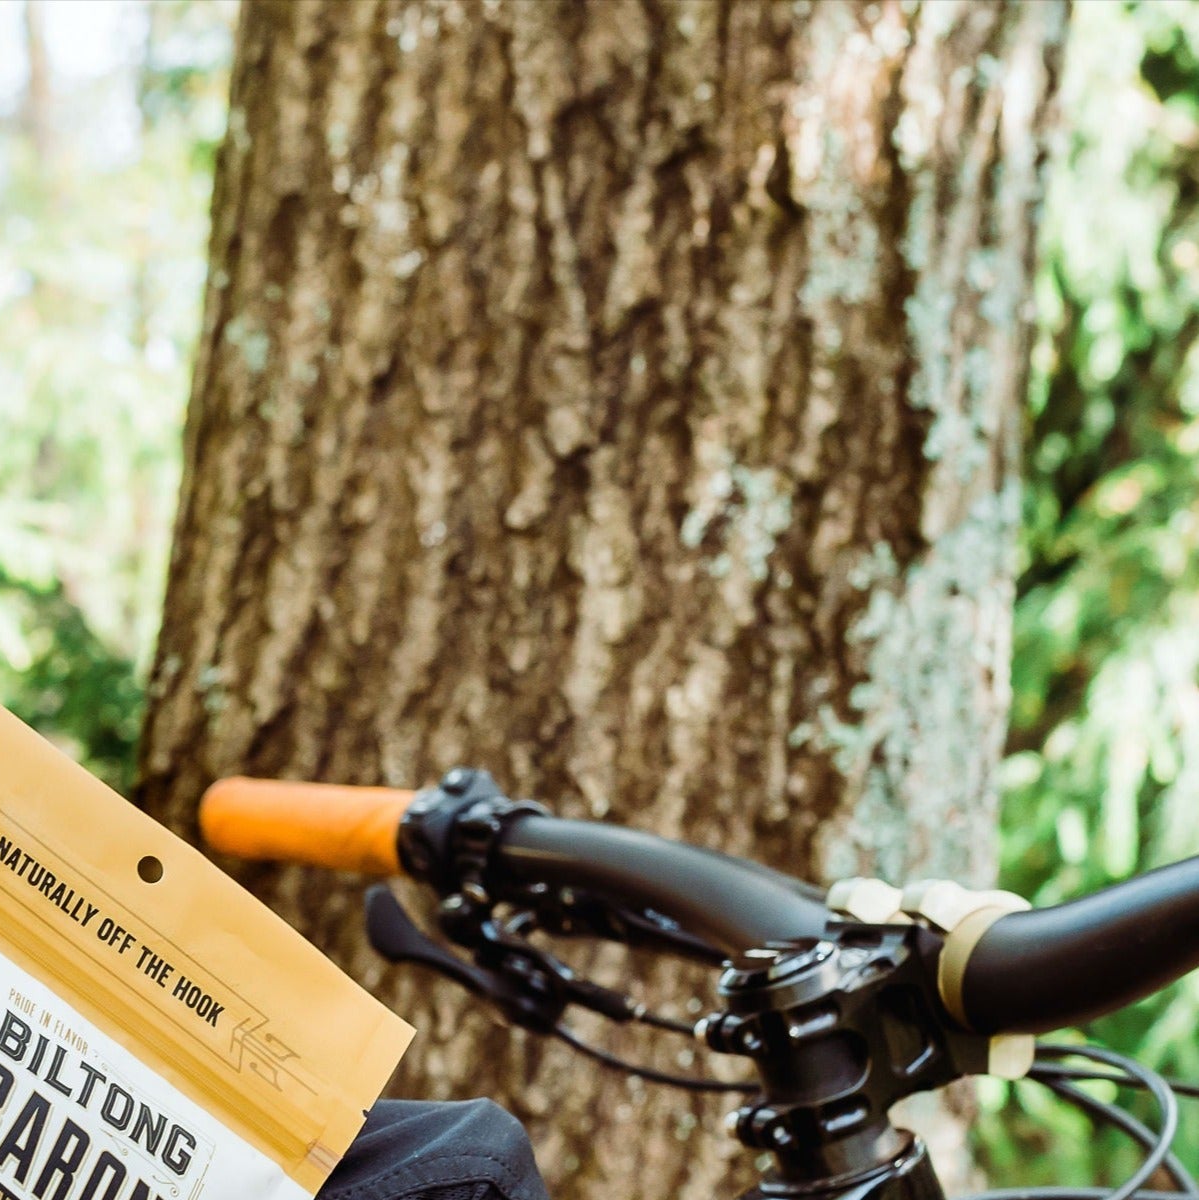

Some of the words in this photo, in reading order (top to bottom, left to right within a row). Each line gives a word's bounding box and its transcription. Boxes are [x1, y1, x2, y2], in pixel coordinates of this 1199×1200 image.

[97, 918, 136, 954] OFF
[136, 946, 174, 988] THE
[172, 976, 225, 1027] HOOK
[8, 987, 37, 1018] PRIDE
[39, 1009, 52, 1028] IN
[54, 1019, 89, 1056] FLAVOR
